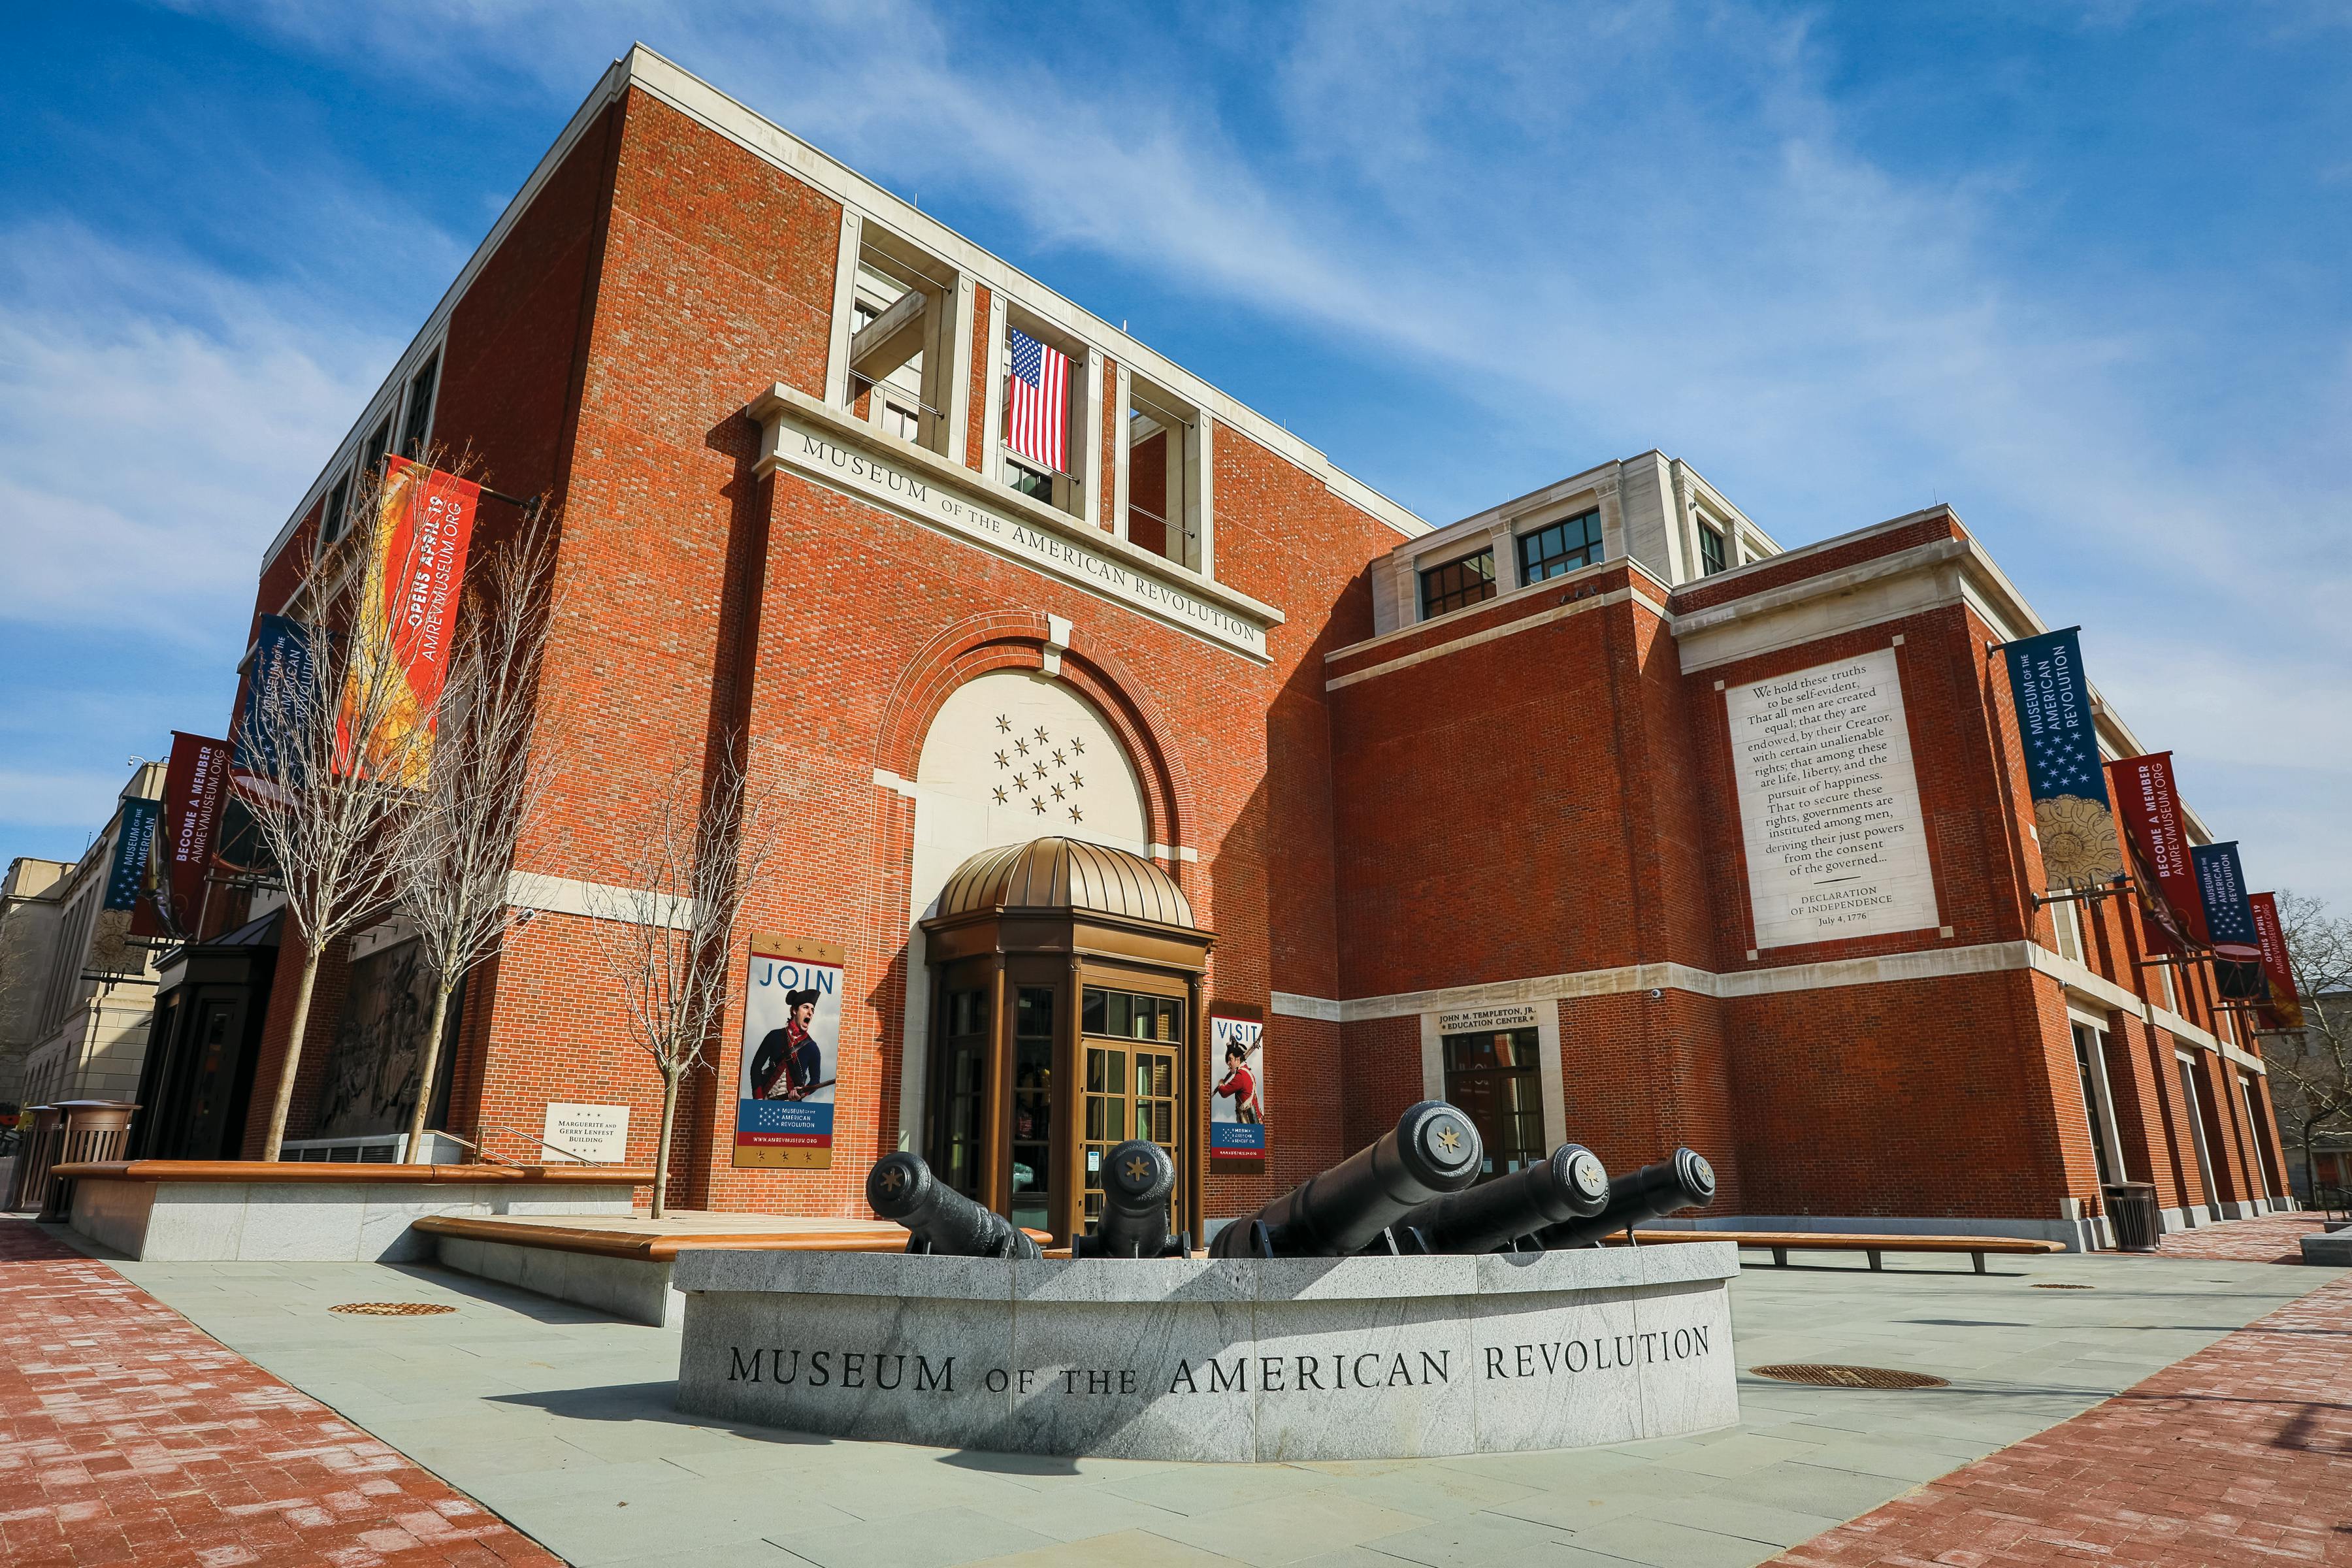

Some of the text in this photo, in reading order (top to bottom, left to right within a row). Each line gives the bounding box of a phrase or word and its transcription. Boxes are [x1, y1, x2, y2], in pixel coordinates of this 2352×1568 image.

[802, 436, 1254, 642] MUSEUM OF THE AMERICAN REVOLUTION
[408, 496, 444, 627] OPENS APRIL 19
[422, 502, 461, 662] AMREVMUSEUM.ORG
[275, 649, 282, 660] OF
[281, 649, 301, 715] AMERICAN
[1753, 666, 1867, 698] We hold these truths
[1781, 696, 1793, 706] be
[1797, 681, 1860, 702] self-evident,
[2021, 654, 2044, 735] MUSEUM OF THE
[2037, 661, 2061, 730] AMERICAN
[2053, 645, 2079, 727] REVOLUTION
[1748, 687, 1876, 725] That all men are created
[1765, 704, 1867, 734] equal; that they are
[1748, 713, 1893, 751] endowed, by their Creator,
[1753, 728, 1884, 763] with certain unalienable
[1755, 742, 1887, 777] rights; that among these
[1778, 773, 1800, 783] life,
[1803, 764, 1842, 779] liberty,
[1844, 759, 1865, 771] and
[1869, 755, 1887, 765] the
[176, 811, 197, 862] BECOME
[191, 747, 212, 794] MEMBER
[1767, 786, 1882, 813] That to secure these
[1768, 773, 1882, 803] pursuit of happiness.
[2138, 766, 2156, 811] MEMBER
[191, 749, 224, 863] AMREVMUSEUM.ORG
[1766, 797, 1893, 828] rights, governments are
[2152, 763, 2185, 875] AMREVMUSEUM.ORG
[1766, 824, 1904, 853] deriving their just powers
[1769, 811, 1893, 838] instituted among men,
[123, 827, 140, 865] MUSEUM
[137, 817, 155, 867] AMERICAN
[1785, 840, 1884, 863] from the consent
[2151, 828, 2170, 877] BECOME
[1789, 853, 1887, 876] of the governed...
[2221, 854, 2238, 902] REVOLUTION
[1801, 886, 1877, 904] DECLARATION
[2204, 873, 2216, 904] MUSEUM
[2212, 862, 2227, 903] AMERICAN
[1791, 894, 1893, 915] OF INDEPENDENCE
[1819, 917, 1835, 926] July
[1848, 912, 1867, 921] 1776
[2257, 913, 2266, 936] APRIL
[2262, 904, 2285, 974] AMREVMUSEUM.ORG
[2261, 938, 2272, 962] OPENS
[759, 963, 834, 994] JOIN
[1217, 1021, 1257, 1042] VISIT
[1439, 1015, 1460, 1024] JOHN
[1473, 1008, 1522, 1019] TEMPLETON,
[1448, 1016, 1528, 1030] EDUCATION CENTER
[728, 1325, 1709, 1395] MUSEUM OF THE AMERICAN REVOLUTION
